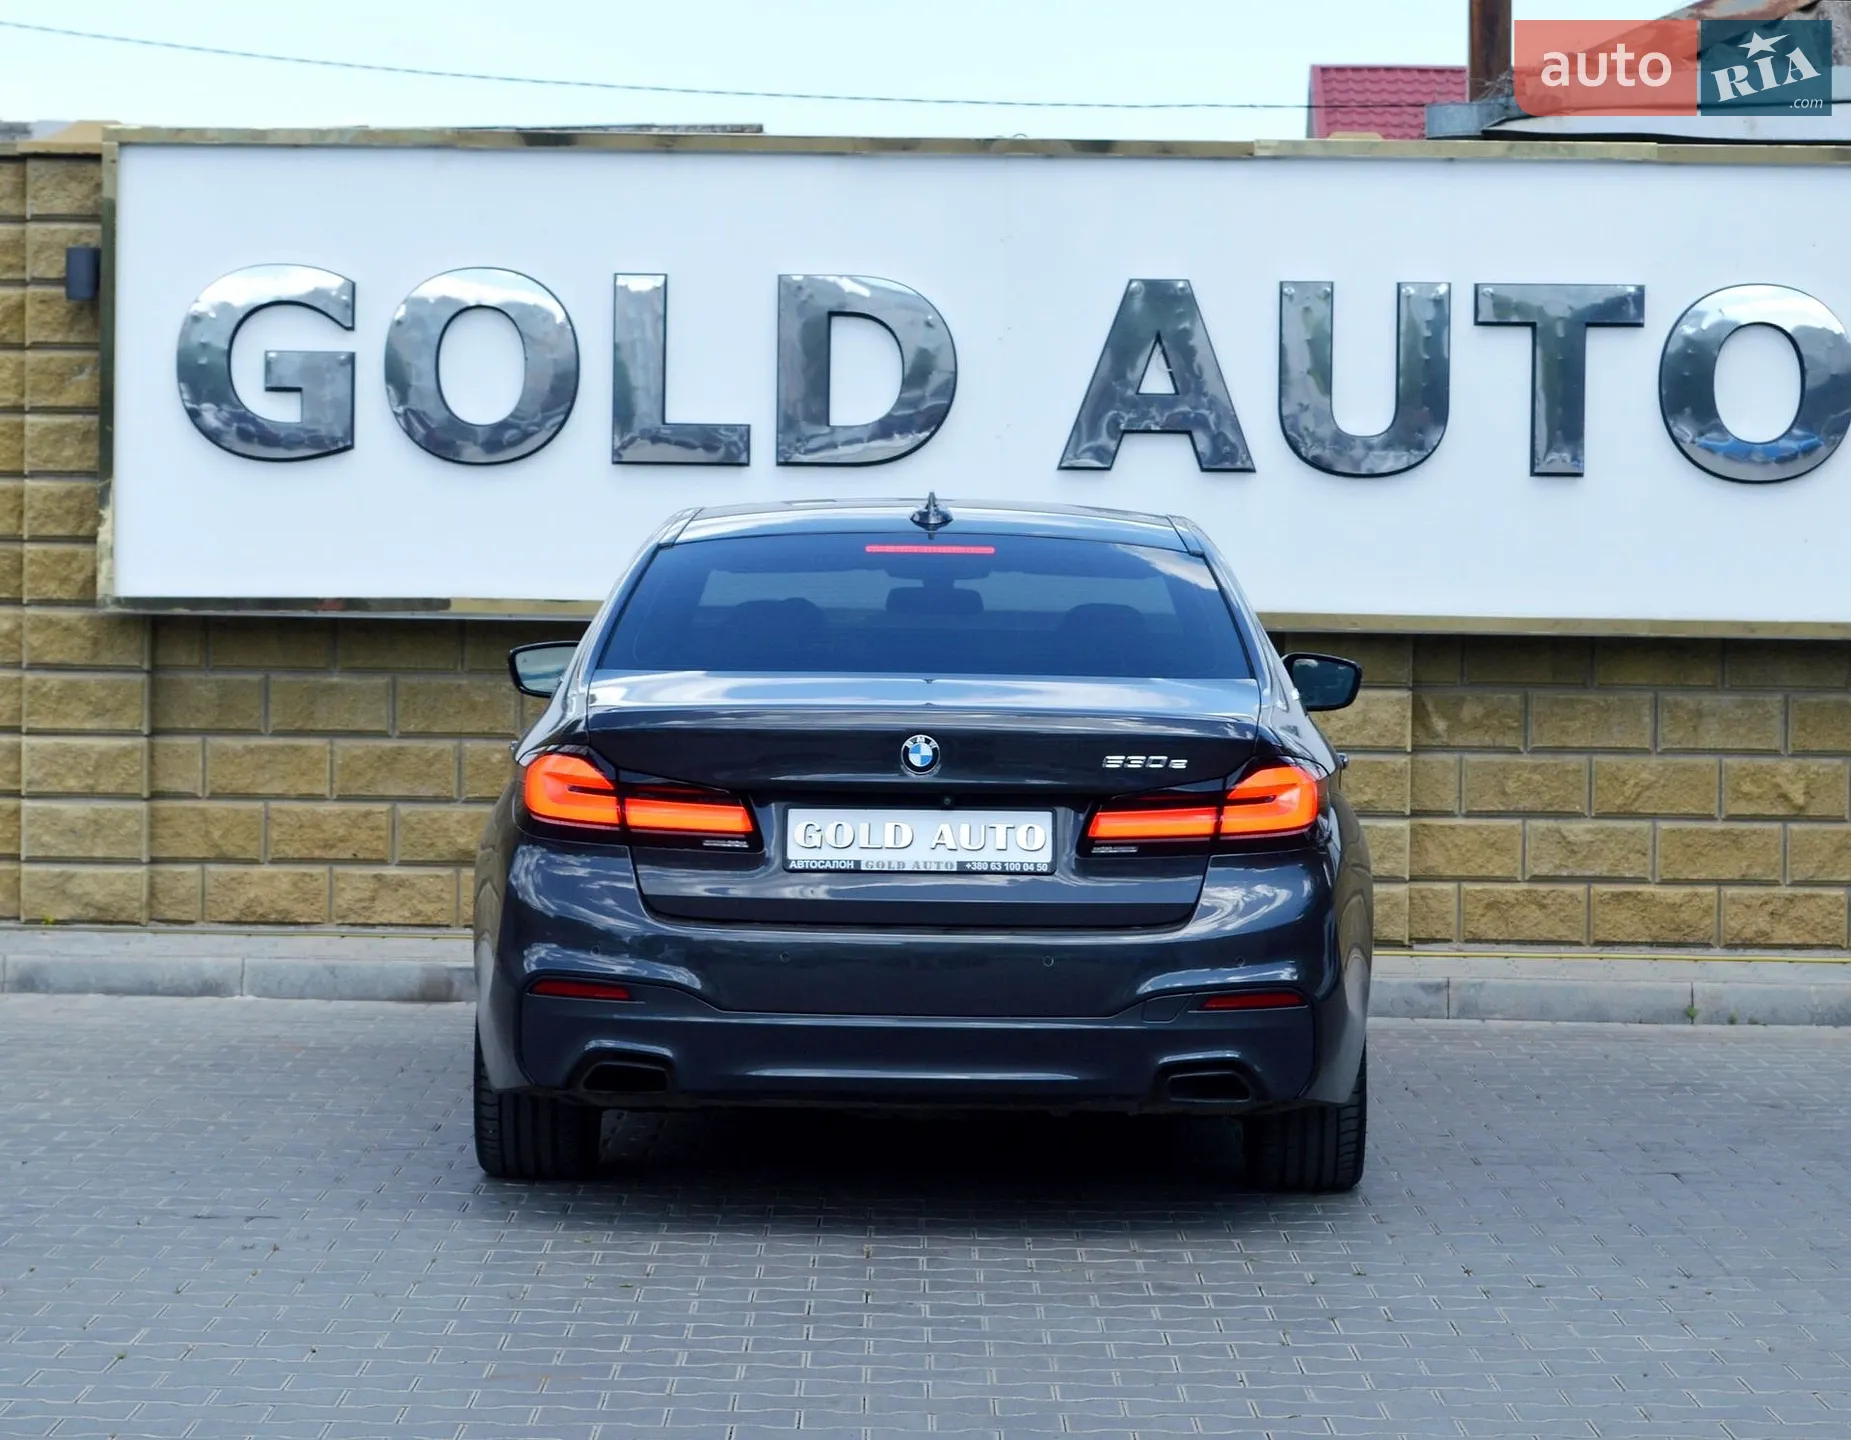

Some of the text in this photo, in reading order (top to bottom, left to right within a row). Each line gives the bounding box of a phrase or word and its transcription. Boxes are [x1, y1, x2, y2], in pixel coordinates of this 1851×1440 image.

[176, 263, 1851, 483] GOLD AUTO
[793, 820, 1047, 852] GOLD AUTO
[789, 860, 854, 869] АВТОСАЛОН
[865, 860, 955, 871] GOLD AUTO
[965, 862, 1048, 872] +380 63 100 04 50
